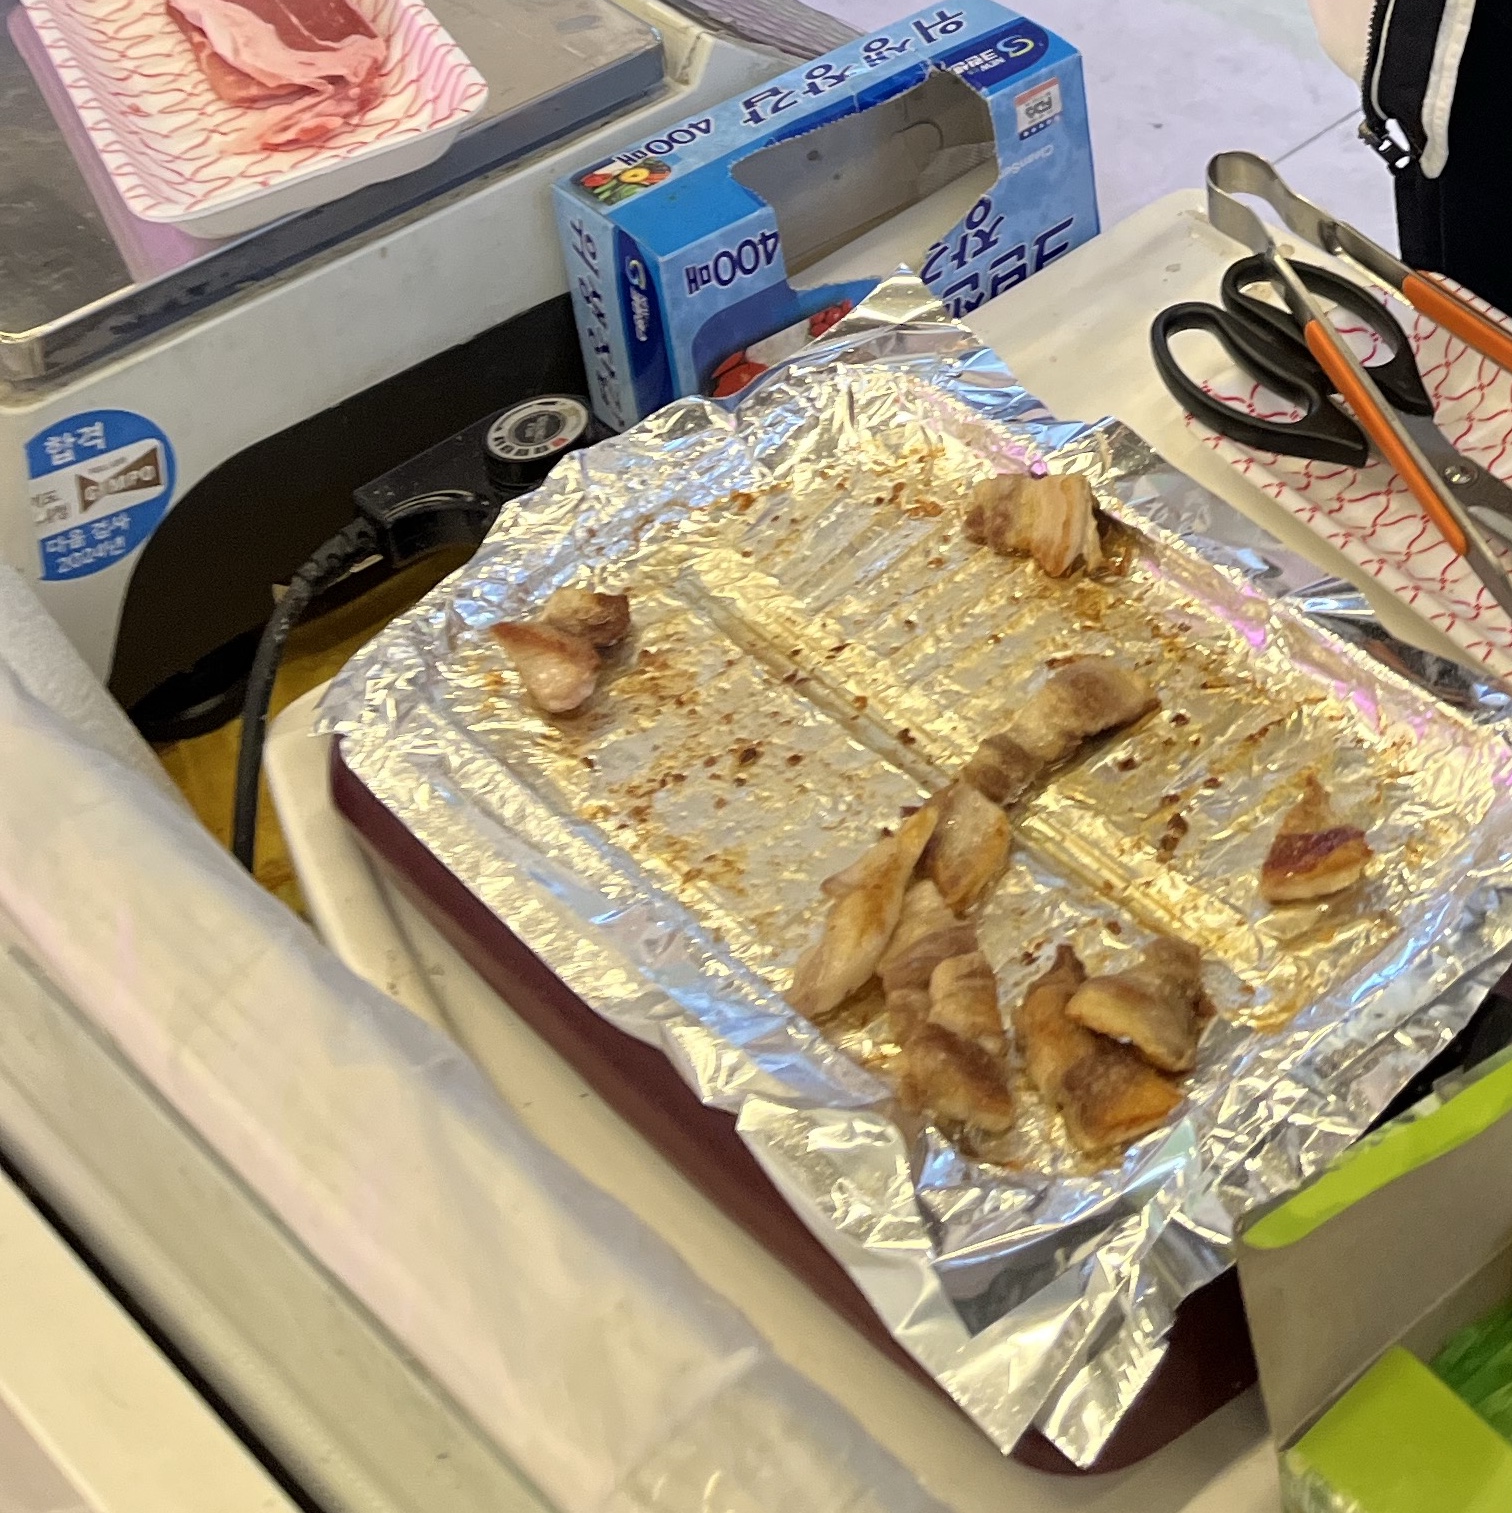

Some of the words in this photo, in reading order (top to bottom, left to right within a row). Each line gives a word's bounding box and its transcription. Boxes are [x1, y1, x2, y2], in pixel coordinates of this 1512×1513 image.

[742, 10, 964, 125] 위생장갑
[615, 117, 712, 167] 400매
[684, 231, 779, 296] 400매
[43, 421, 108, 466] 합격
